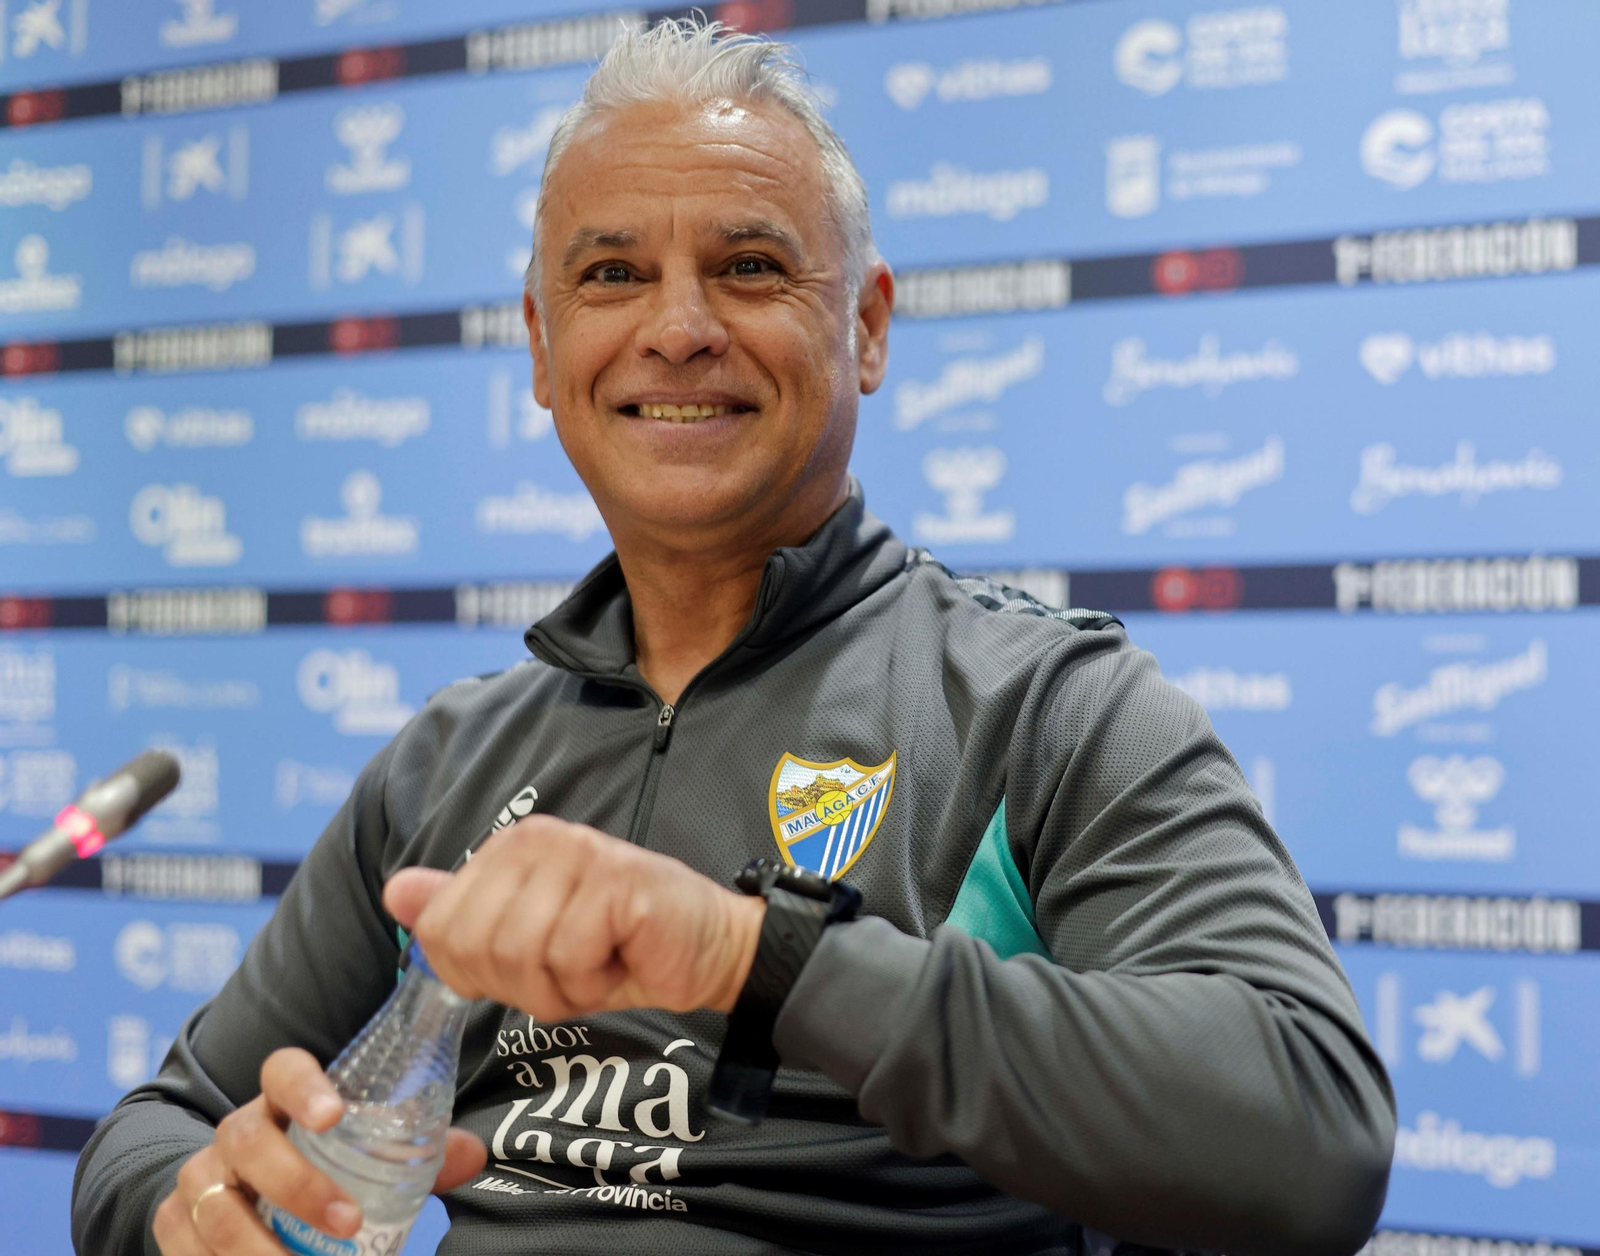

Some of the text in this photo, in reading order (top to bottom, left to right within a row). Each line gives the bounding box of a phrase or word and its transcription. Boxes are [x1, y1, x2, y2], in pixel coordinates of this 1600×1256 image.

[786, 774, 882, 835] MALAGA C.F.
[496, 1014, 593, 1057] sabor
[507, 1038, 706, 1142] a má
